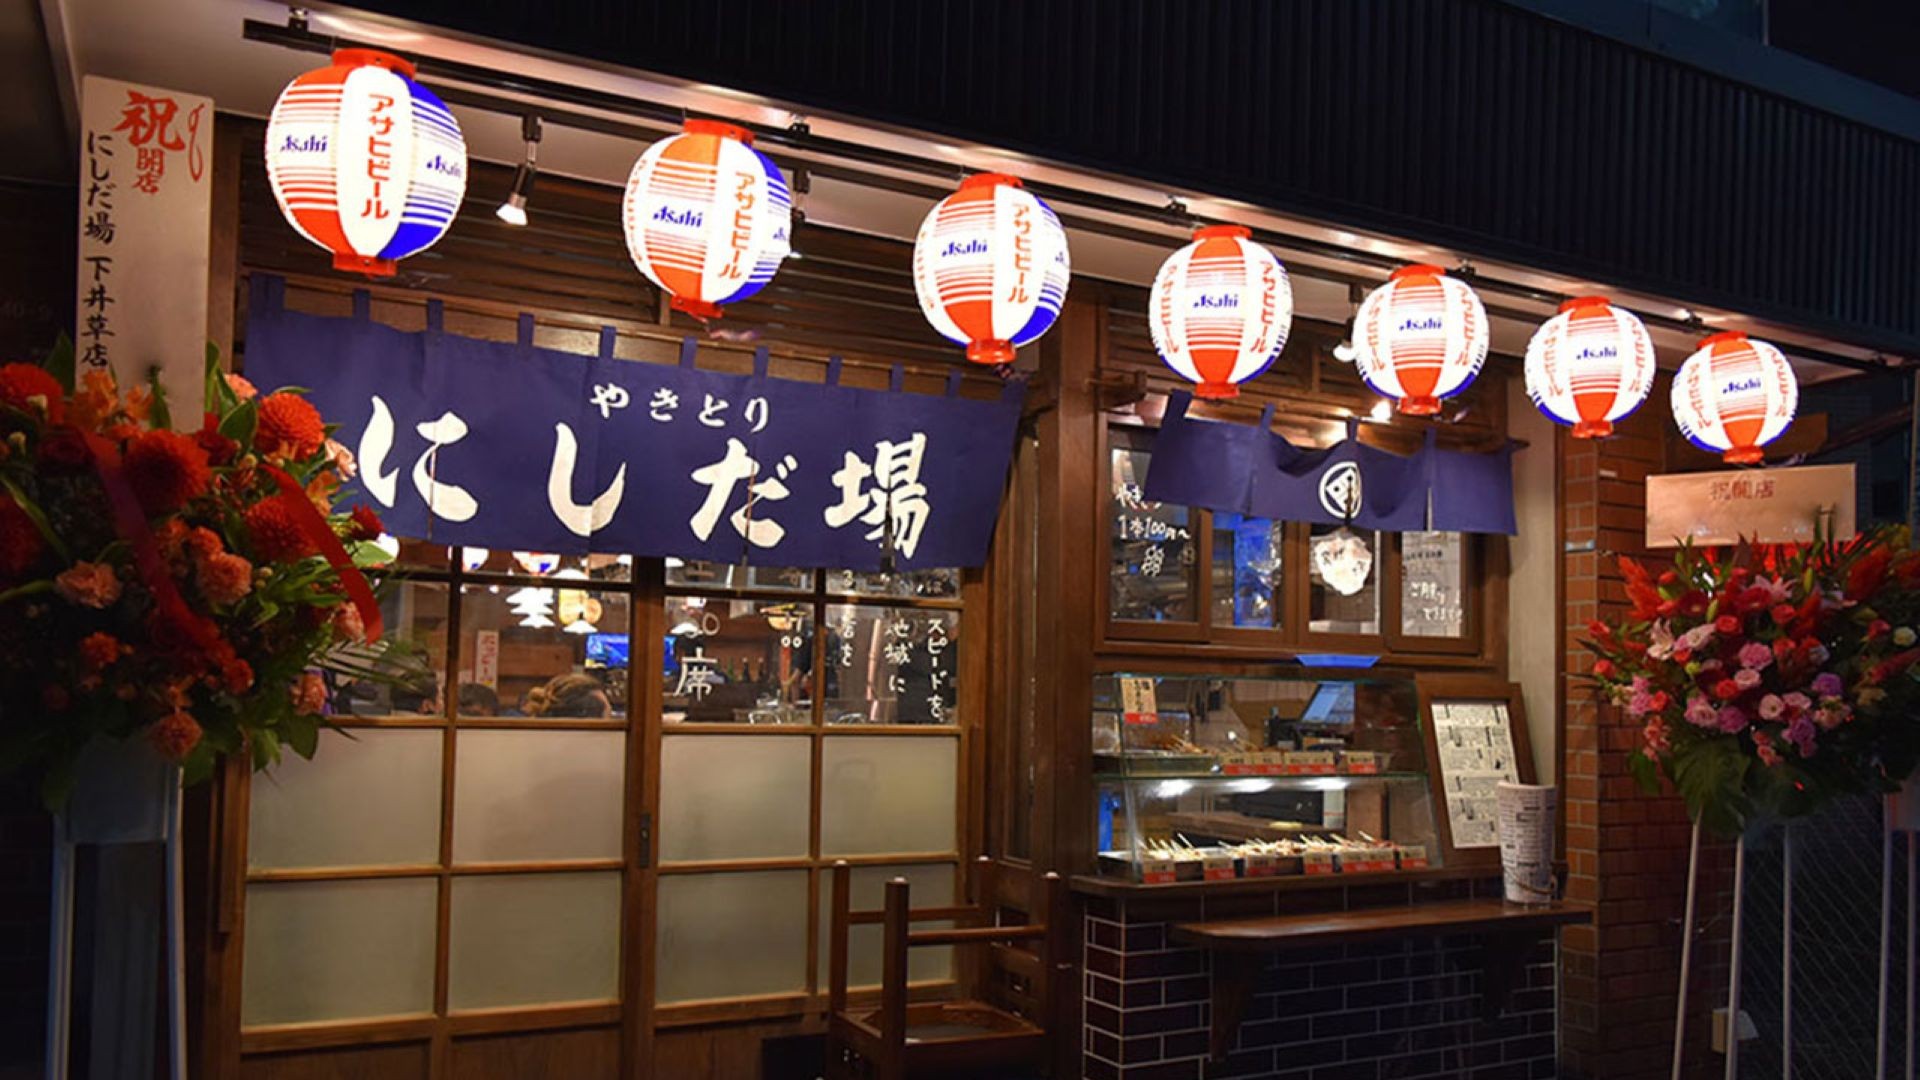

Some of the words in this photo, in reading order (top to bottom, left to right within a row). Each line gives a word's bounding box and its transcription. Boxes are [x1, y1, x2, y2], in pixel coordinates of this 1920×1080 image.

[280, 133, 328, 152] Asahi
[360, 92, 395, 219] アサヒビール
[85, 130, 116, 245] にしだ場
[652, 204, 704, 228] Asahi
[718, 170, 756, 280] アサヒビール
[941, 238, 988, 258] Asahi
[1008, 202, 1032, 305] アサヒビール
[80, 256, 116, 368] 下井草店
[1192, 293, 1239, 309] Asahi
[1249, 260, 1276, 354] アサヒビール
[1399, 318, 1443, 332] Asahi
[1575, 346, 1618, 360] Asahi
[590, 382, 769, 434] やきとり
[1721, 377, 1762, 394] Asahi
[358, 395, 931, 559] にしだ場
